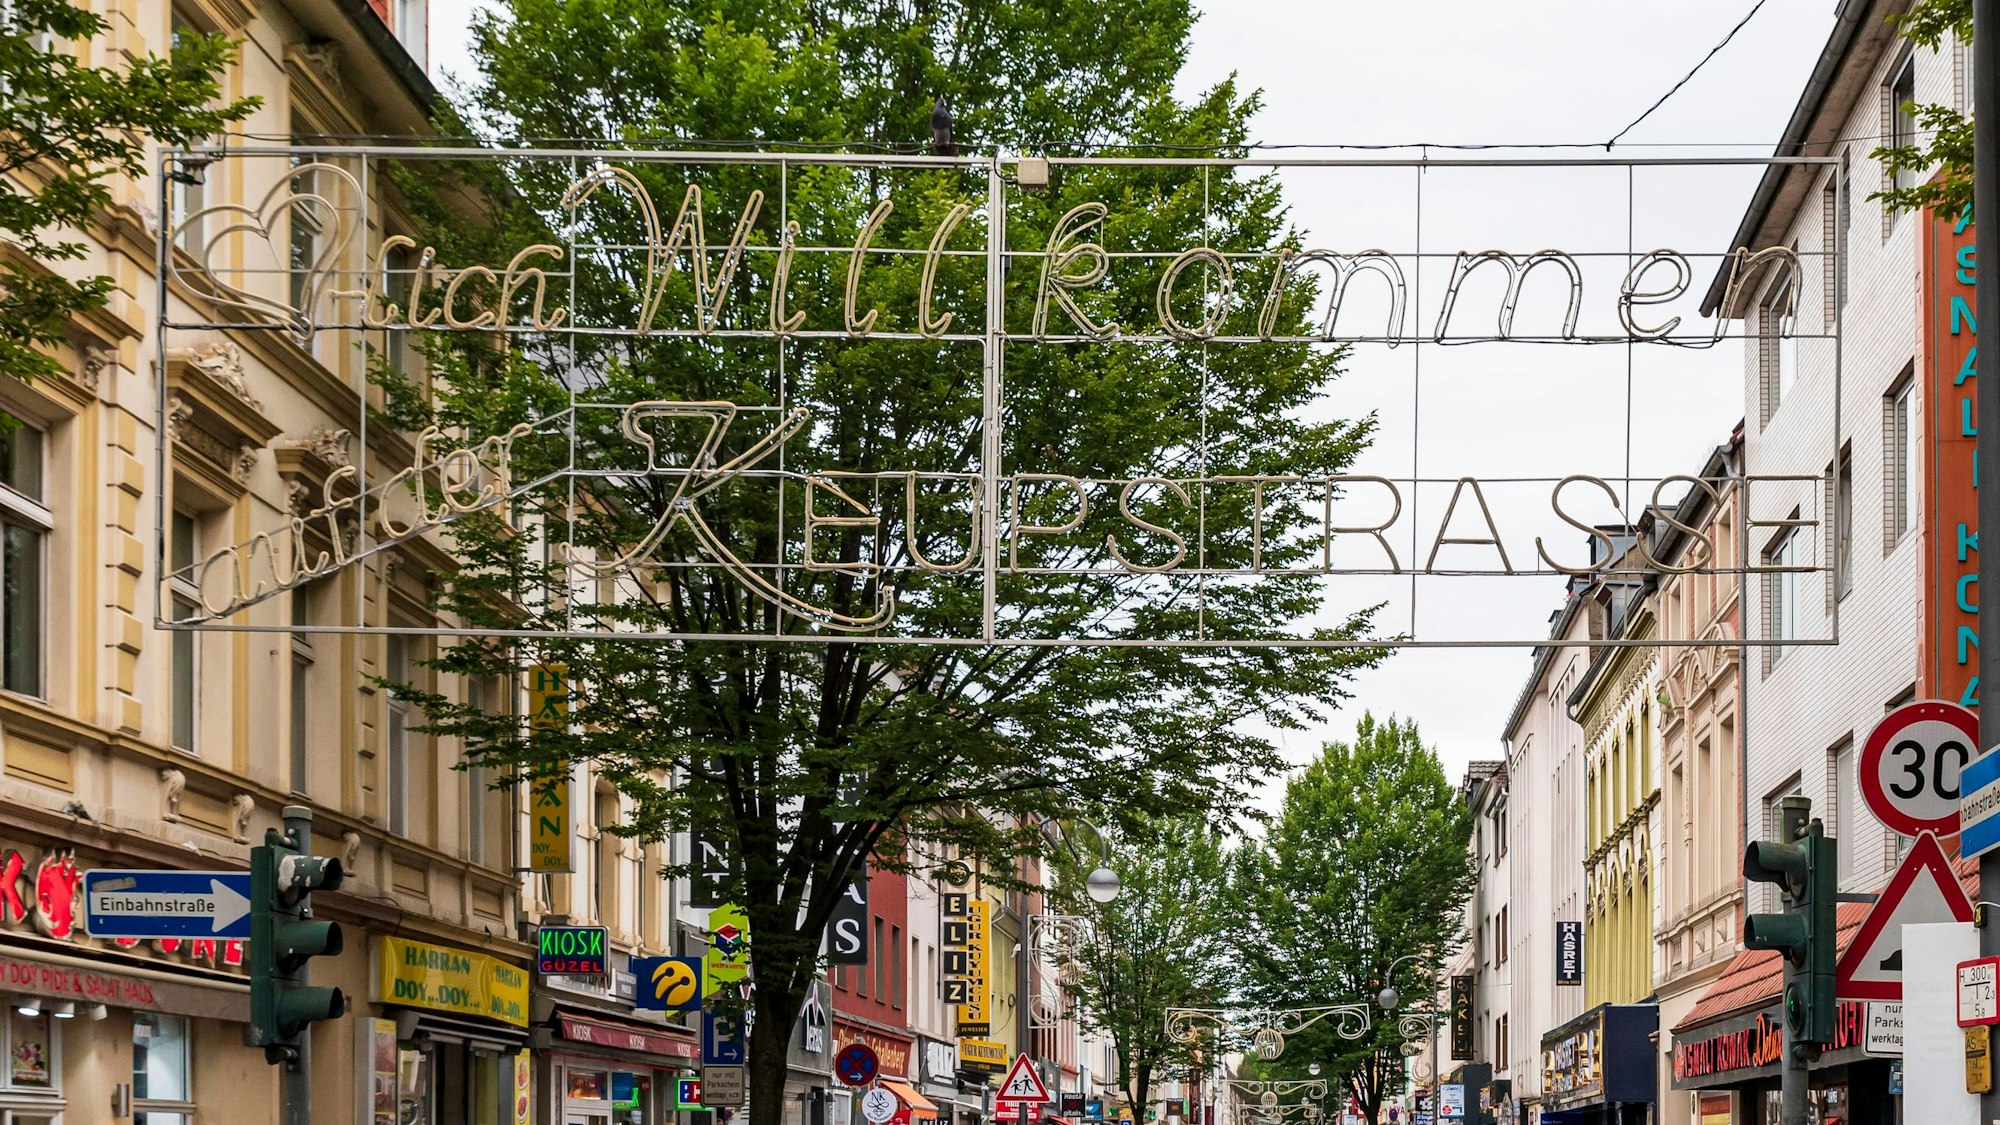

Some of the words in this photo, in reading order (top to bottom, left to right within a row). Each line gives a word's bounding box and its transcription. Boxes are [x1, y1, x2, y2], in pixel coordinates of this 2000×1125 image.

[562, 167, 1802, 349] Willkommen
[201, 466, 356, 618] auf
[380, 423, 532, 537] der
[558, 400, 1820, 631] KEUPSTRASSE
[537, 671, 562, 837] HAAN
[1889, 740, 1968, 800] 30
[101, 897, 215, 913] Einbahnstraße
[405, 946, 471, 975] HARRAN
[541, 931, 602, 956] KIOSK
[949, 896, 962, 1000] ELIZ
[1563, 922, 1576, 979] HASRET
[541, 959, 603, 972] GÜZEL
[1970, 966, 1987, 982] 300
[41, 968, 69, 992] PIDE
[73, 973, 82, 993] &
[86, 975, 121, 998] SALAT
[124, 983, 154, 1004] HAUS
[572, 1024, 592, 1042] KIOSK
[629, 1035, 646, 1051] KIOSK
[677, 1043, 693, 1058] KIOSK
[1717, 1029, 1751, 1072] KONAK
